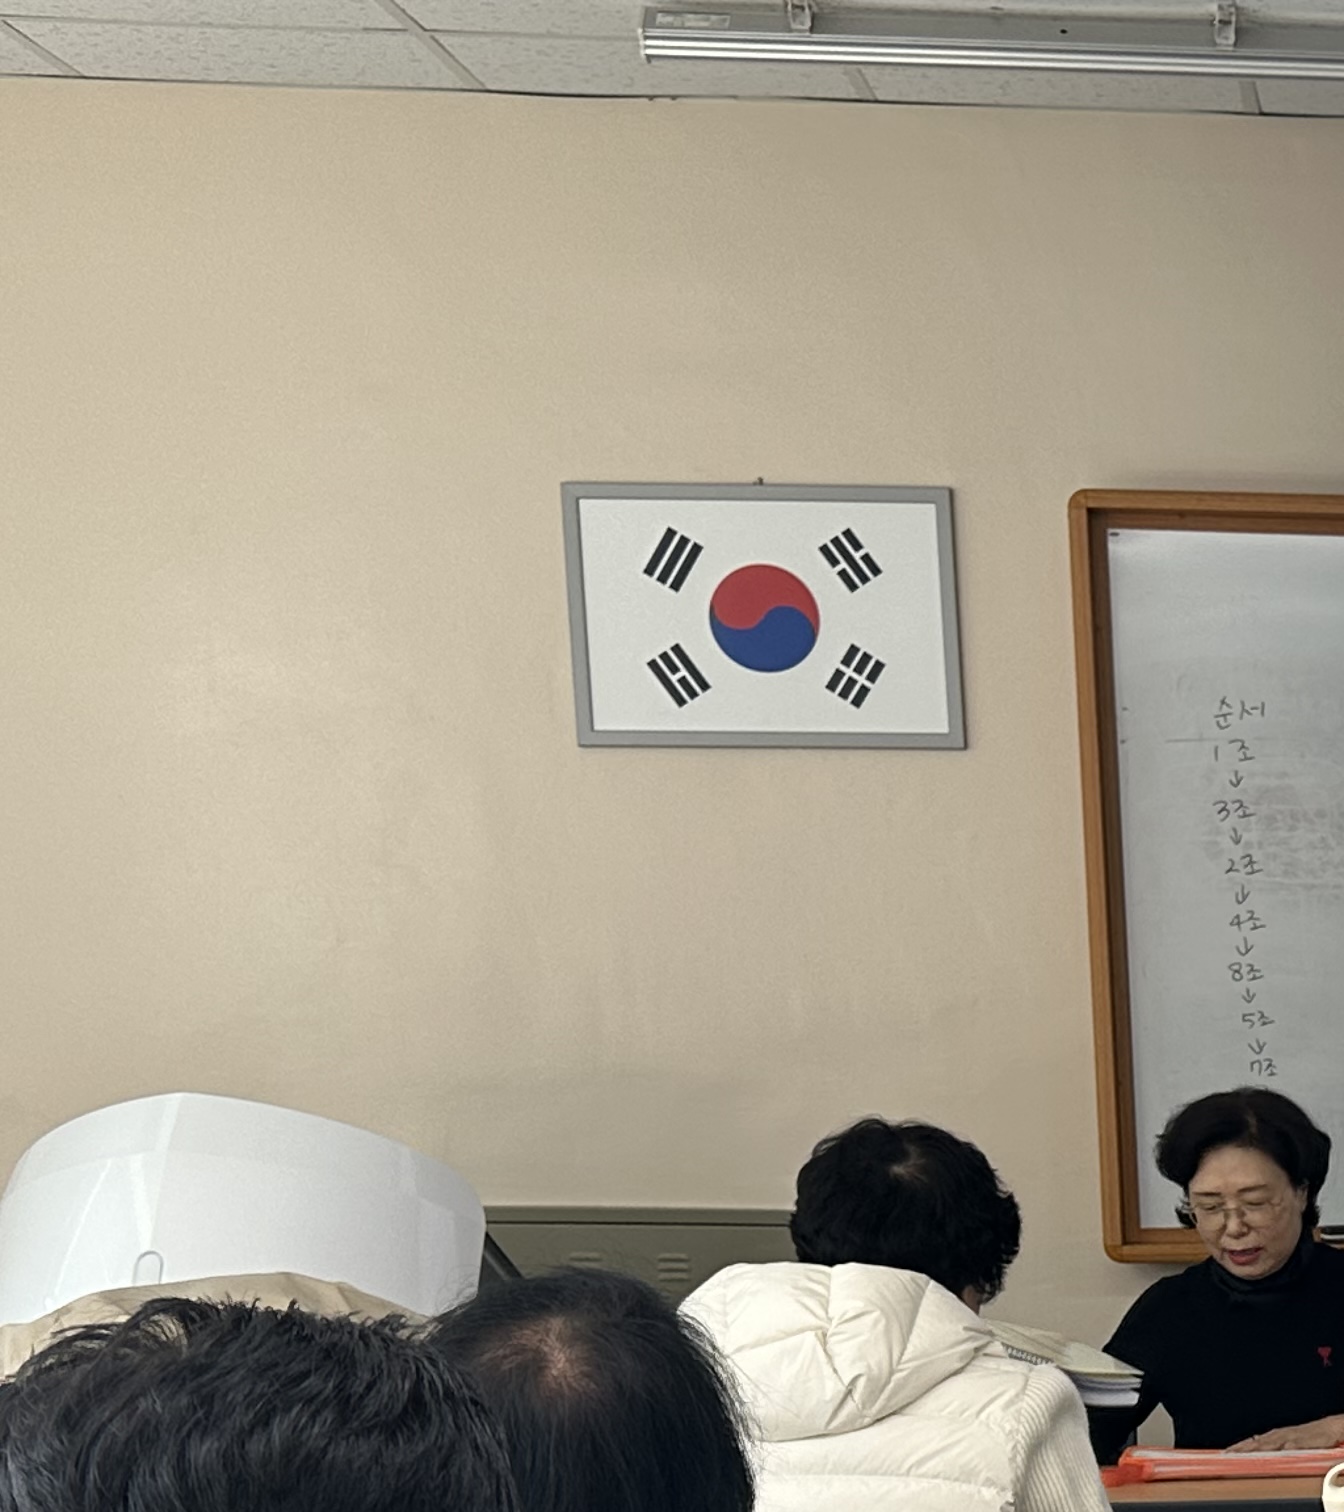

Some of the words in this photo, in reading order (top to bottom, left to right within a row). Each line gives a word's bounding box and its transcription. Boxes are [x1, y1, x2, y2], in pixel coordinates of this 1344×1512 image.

[1213, 696, 1266, 730] 순서
[1212, 800, 1256, 822] 3조
[1224, 854, 1263, 876] 2조
[1229, 910, 1266, 931] 4조
[1228, 962, 1264, 983] 8조
[1241, 1010, 1275, 1029] 5조
[1249, 1058, 1278, 1077] 7조
